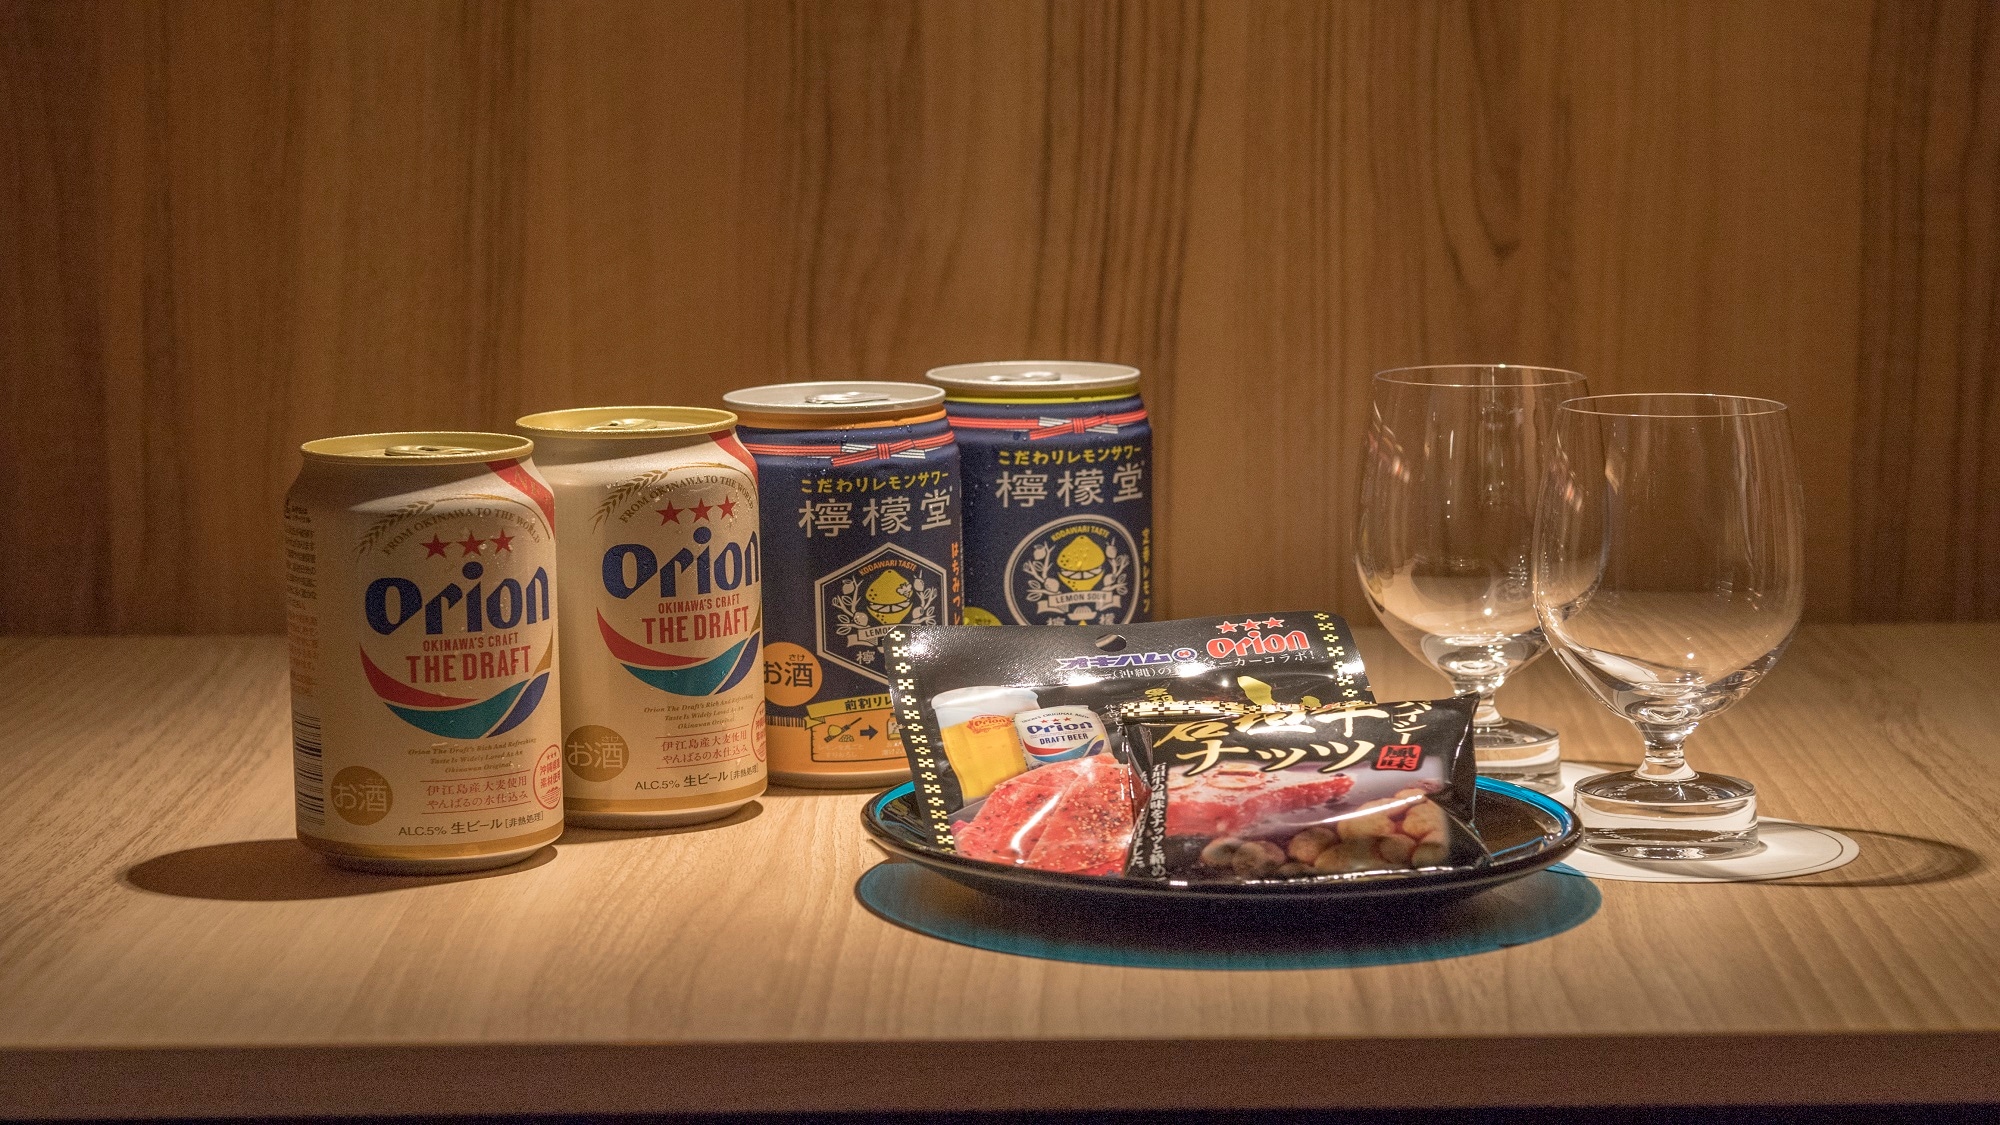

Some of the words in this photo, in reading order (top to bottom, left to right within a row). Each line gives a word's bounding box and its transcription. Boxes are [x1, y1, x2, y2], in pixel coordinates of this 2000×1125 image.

[998, 445, 1142, 466] こだわりレモンサワー
[801, 470, 949, 493] こだわりレモンサワー
[995, 463, 1144, 508] 檸檬堂
[619, 496, 650, 523] FROM
[650, 476, 704, 499] OKINAWA
[703, 475, 718, 484] TO
[720, 476, 736, 489] THE
[736, 482, 753, 509] WORLD
[798, 488, 952, 538] 檸檬堂
[383, 525, 413, 555] FROM
[414, 508, 474, 532] OKINAWA
[475, 507, 491, 518] TO
[494, 508, 515, 522] THE
[516, 515, 540, 544] WORLD
[858, 559, 898, 576] KODAWARI
[898, 559, 918, 572] TASTE
[658, 598, 713, 615] OKINAWA'S
[715, 593, 740, 607] CRAFT
[1055, 593, 1085, 604] LEMON
[642, 615, 689, 645] THE
[693, 606, 749, 641] DRAFT
[865, 626, 893, 637] LEMO
[423, 636, 484, 652] OKINAWA'S
[488, 632, 518, 647] CRAFT
[406, 654, 457, 684] THE
[462, 646, 530, 682] DRAFT
[789, 653, 805, 661] さけ
[1054, 652, 1173, 670] オキハム
[764, 661, 813, 687] お酒
[681, 703, 705, 711] Draft's
[691, 711, 713, 719] Widely
[677, 721, 711, 730] Okinawan
[476, 744, 492, 752] Rich
[1039, 735, 1065, 746] DRAFT
[1067, 733, 1089, 742] BEER
[567, 741, 623, 769] お酒
[1176, 739, 1376, 776] ナッツ
[444, 765, 482, 774] Okinawan
[427, 776, 527, 796] 伊江島産大麦使用
[634, 779, 680, 791] ALC.5%
[683, 771, 729, 788] 生ビール
[333, 783, 388, 812] お酒
[427, 790, 529, 810] やんばるの水仕込み
[398, 825, 447, 837] ALC.5%
[451, 818, 503, 835] 生ビール
